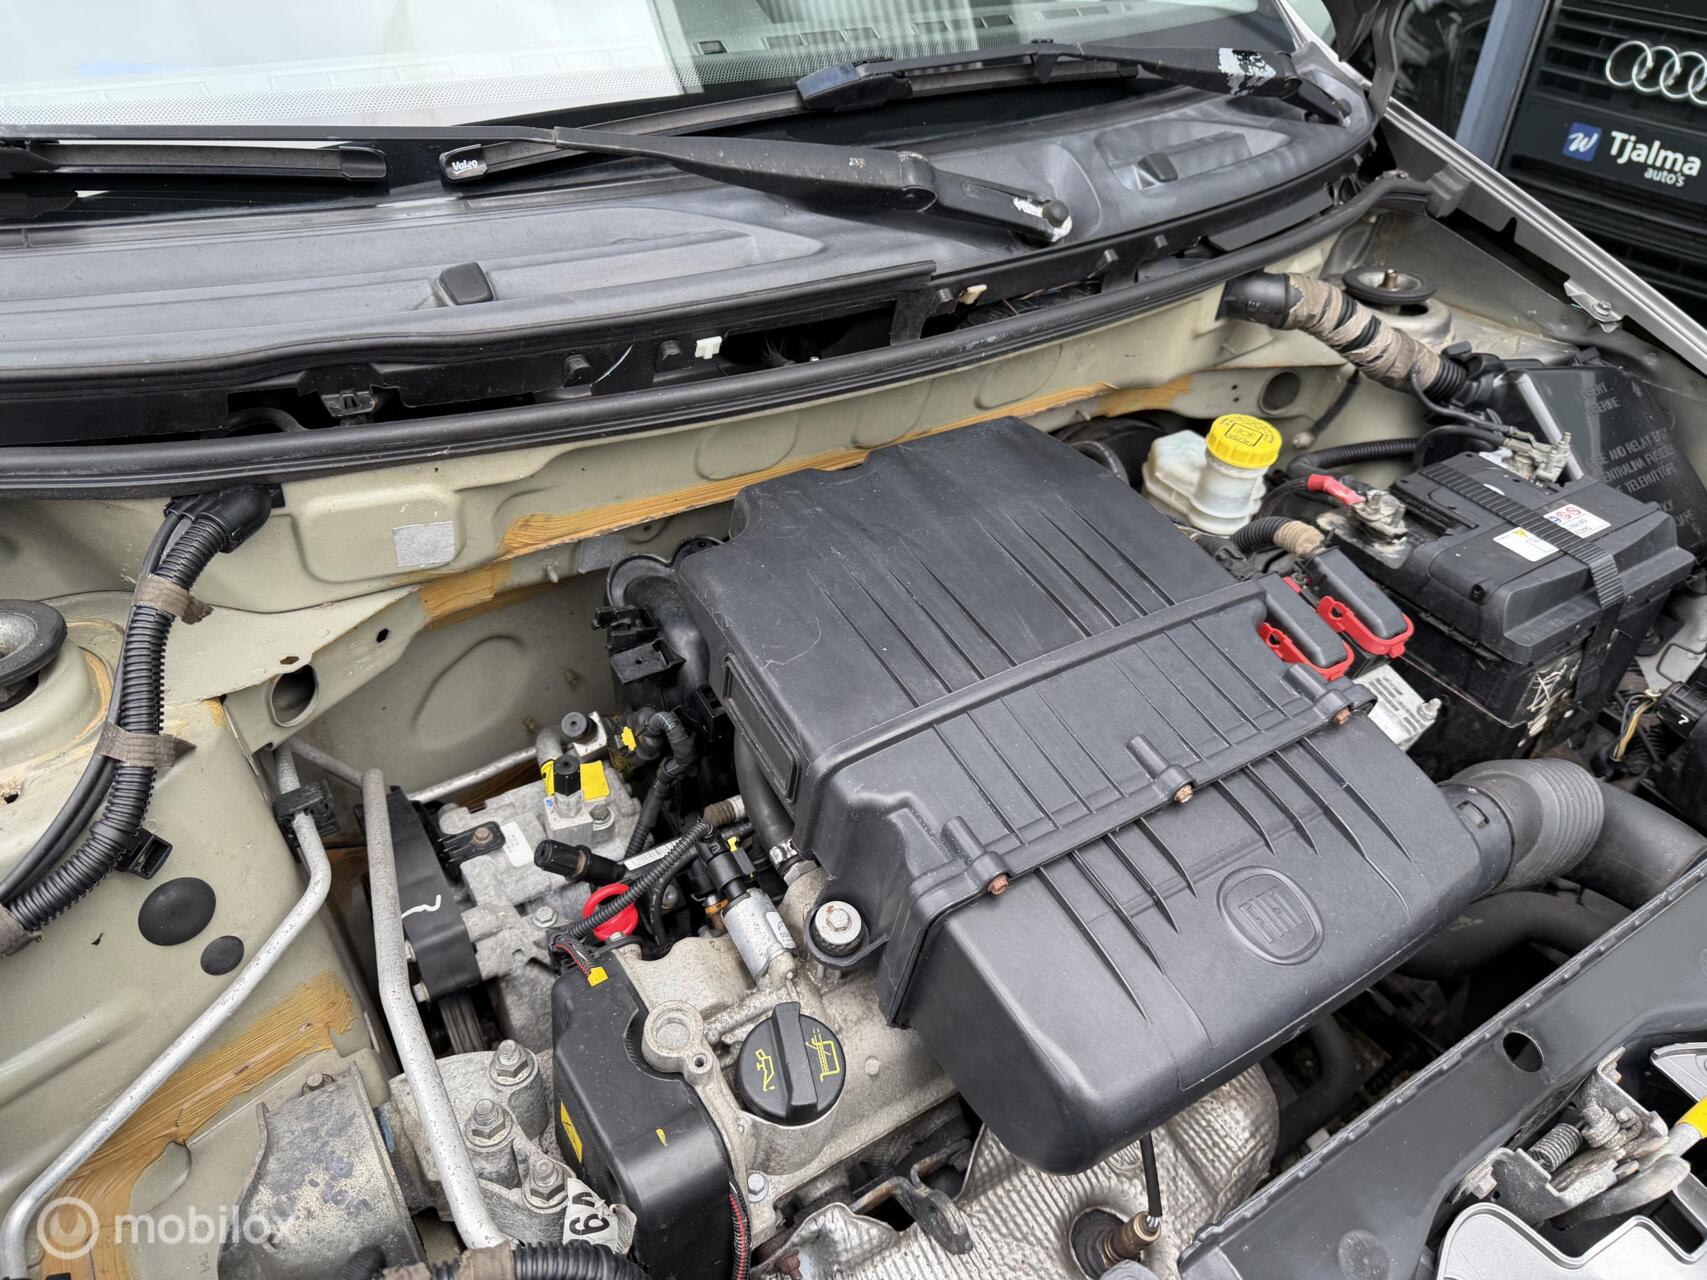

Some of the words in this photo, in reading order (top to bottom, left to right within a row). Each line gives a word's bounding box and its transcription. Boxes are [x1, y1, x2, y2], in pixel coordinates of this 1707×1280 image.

[451, 159, 478, 171] Valeo
[1610, 131, 1702, 176] Tjalma
[1643, 167, 1685, 187] auto's
[1608, 445, 1627, 462] AND
[1625, 433, 1653, 454] RELAY
[1238, 885, 1304, 944] FIAT
